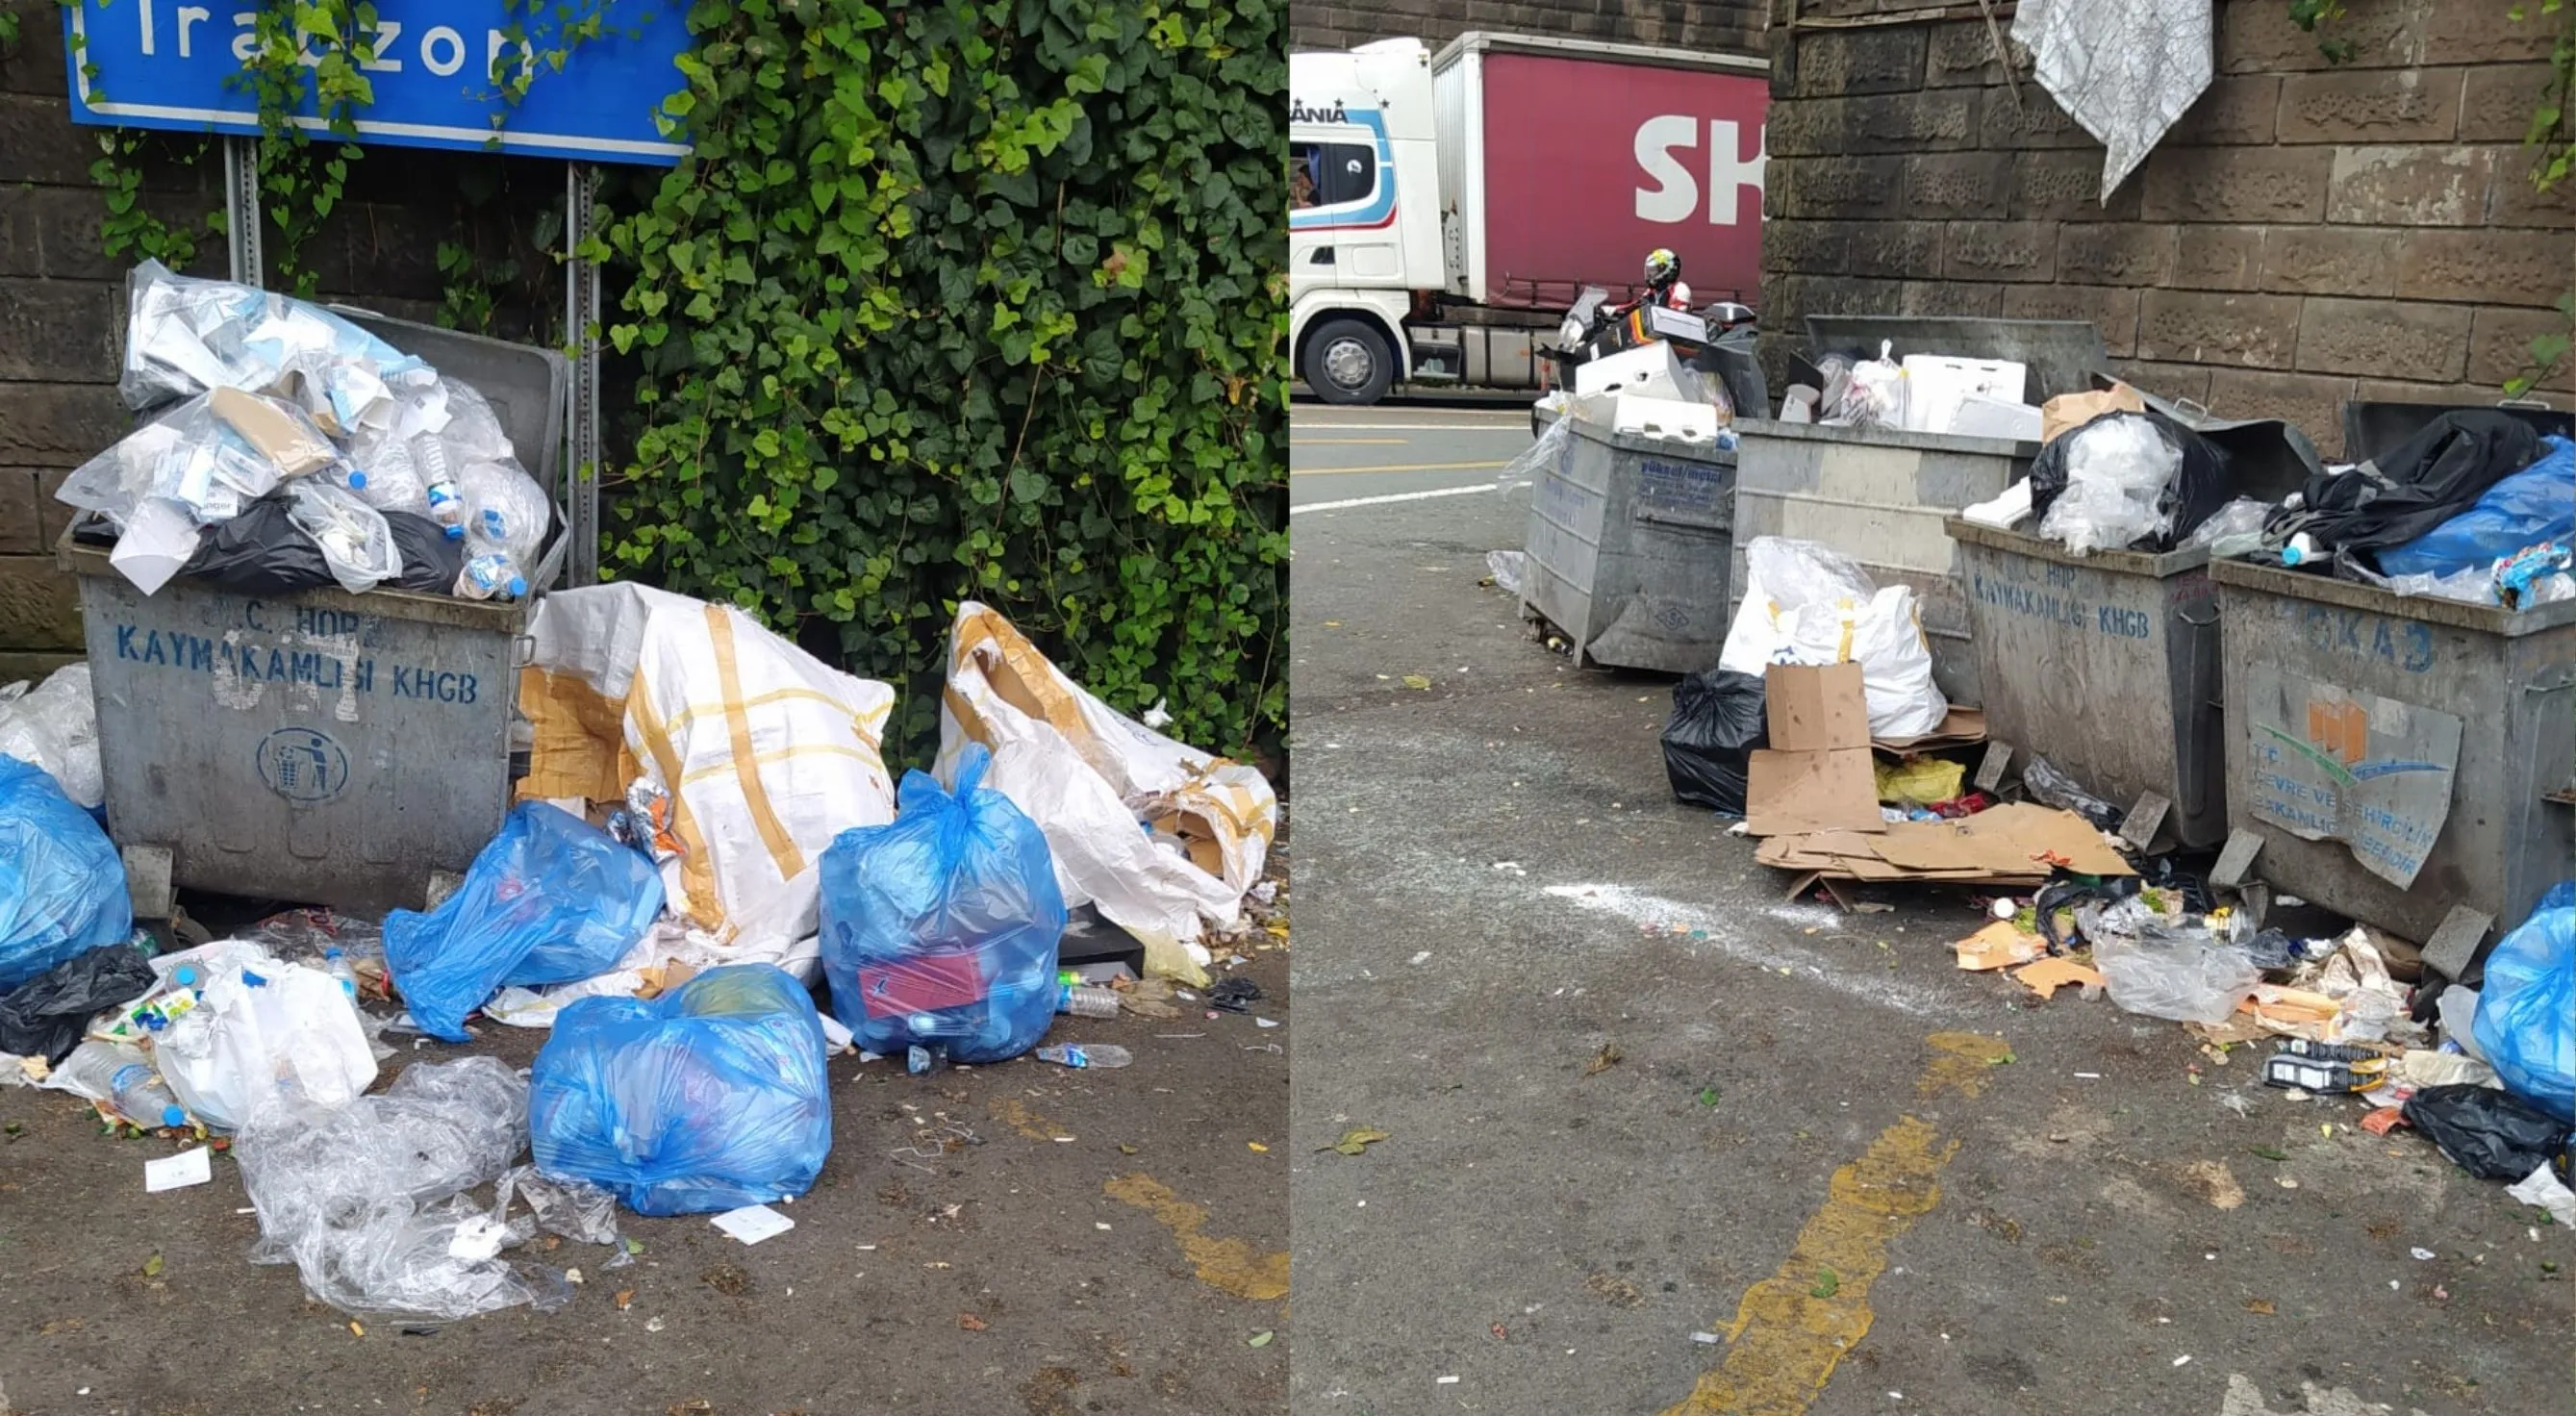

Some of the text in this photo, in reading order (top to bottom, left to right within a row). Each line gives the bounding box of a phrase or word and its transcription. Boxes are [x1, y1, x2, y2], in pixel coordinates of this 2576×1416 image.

[1290, 107, 1349, 123] ANIA
[2099, 605, 2150, 640] KHGB
[393, 665, 478, 705] KHGB
[2313, 789, 2336, 809] VE
